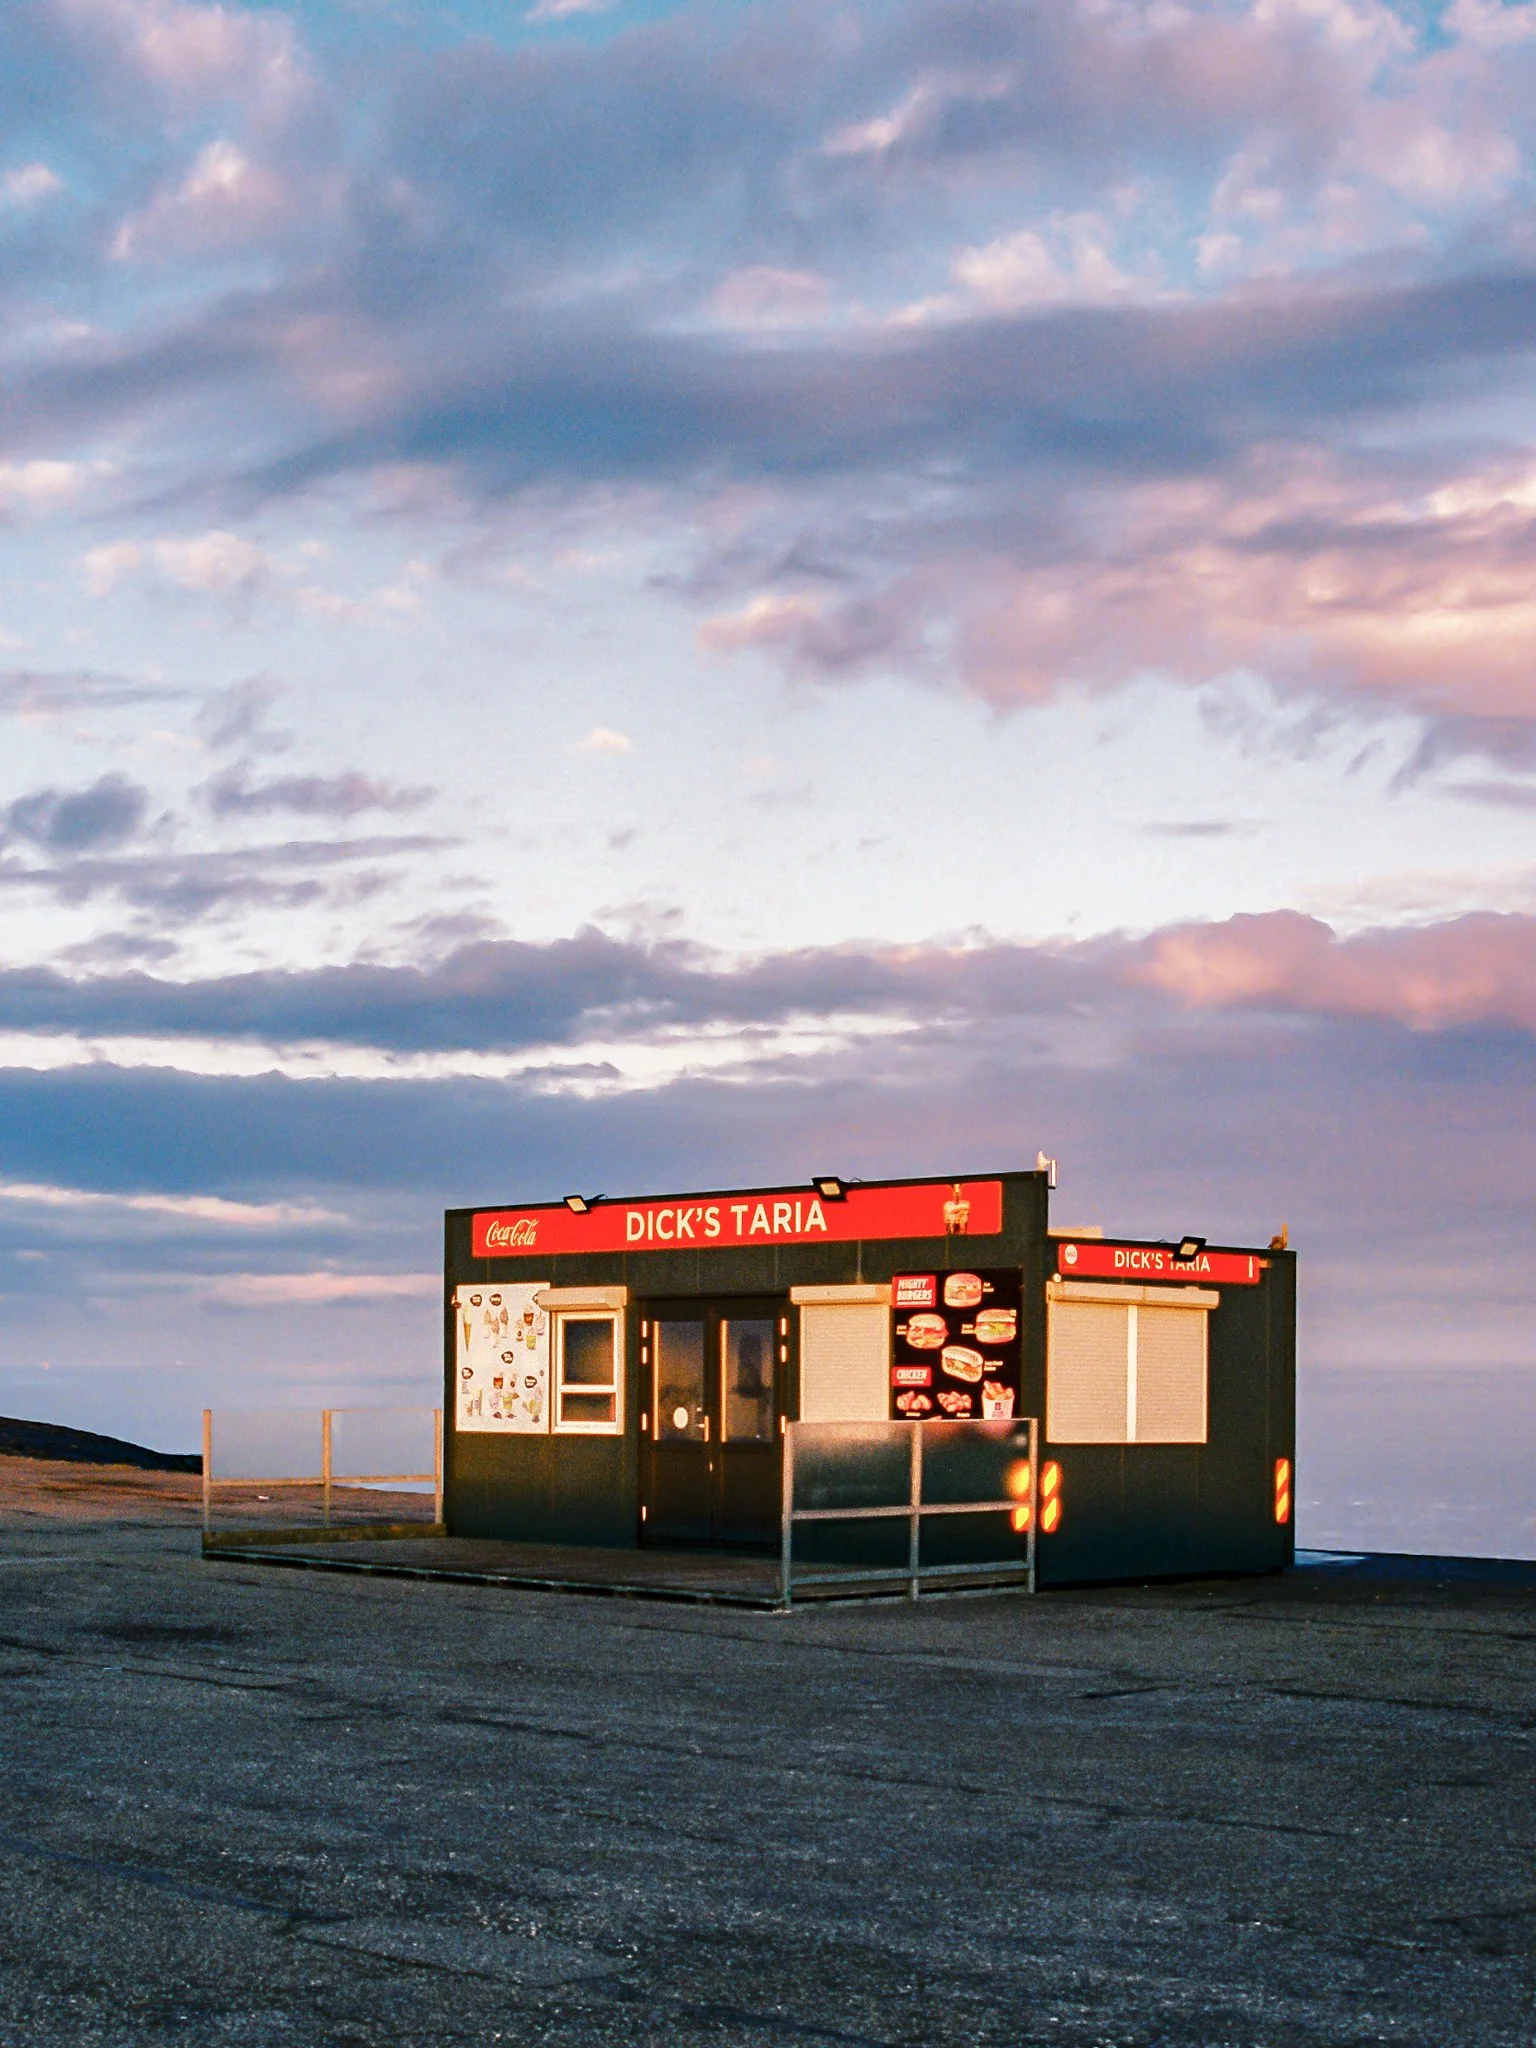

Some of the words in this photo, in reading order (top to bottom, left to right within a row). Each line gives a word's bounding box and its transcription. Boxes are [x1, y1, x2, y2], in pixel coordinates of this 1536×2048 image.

[626, 1205, 721, 1241] DICK'S
[730, 1200, 828, 1236] TARIA
[1114, 1250, 1164, 1270] DICK'S
[896, 1289, 933, 1301] BURGERS
